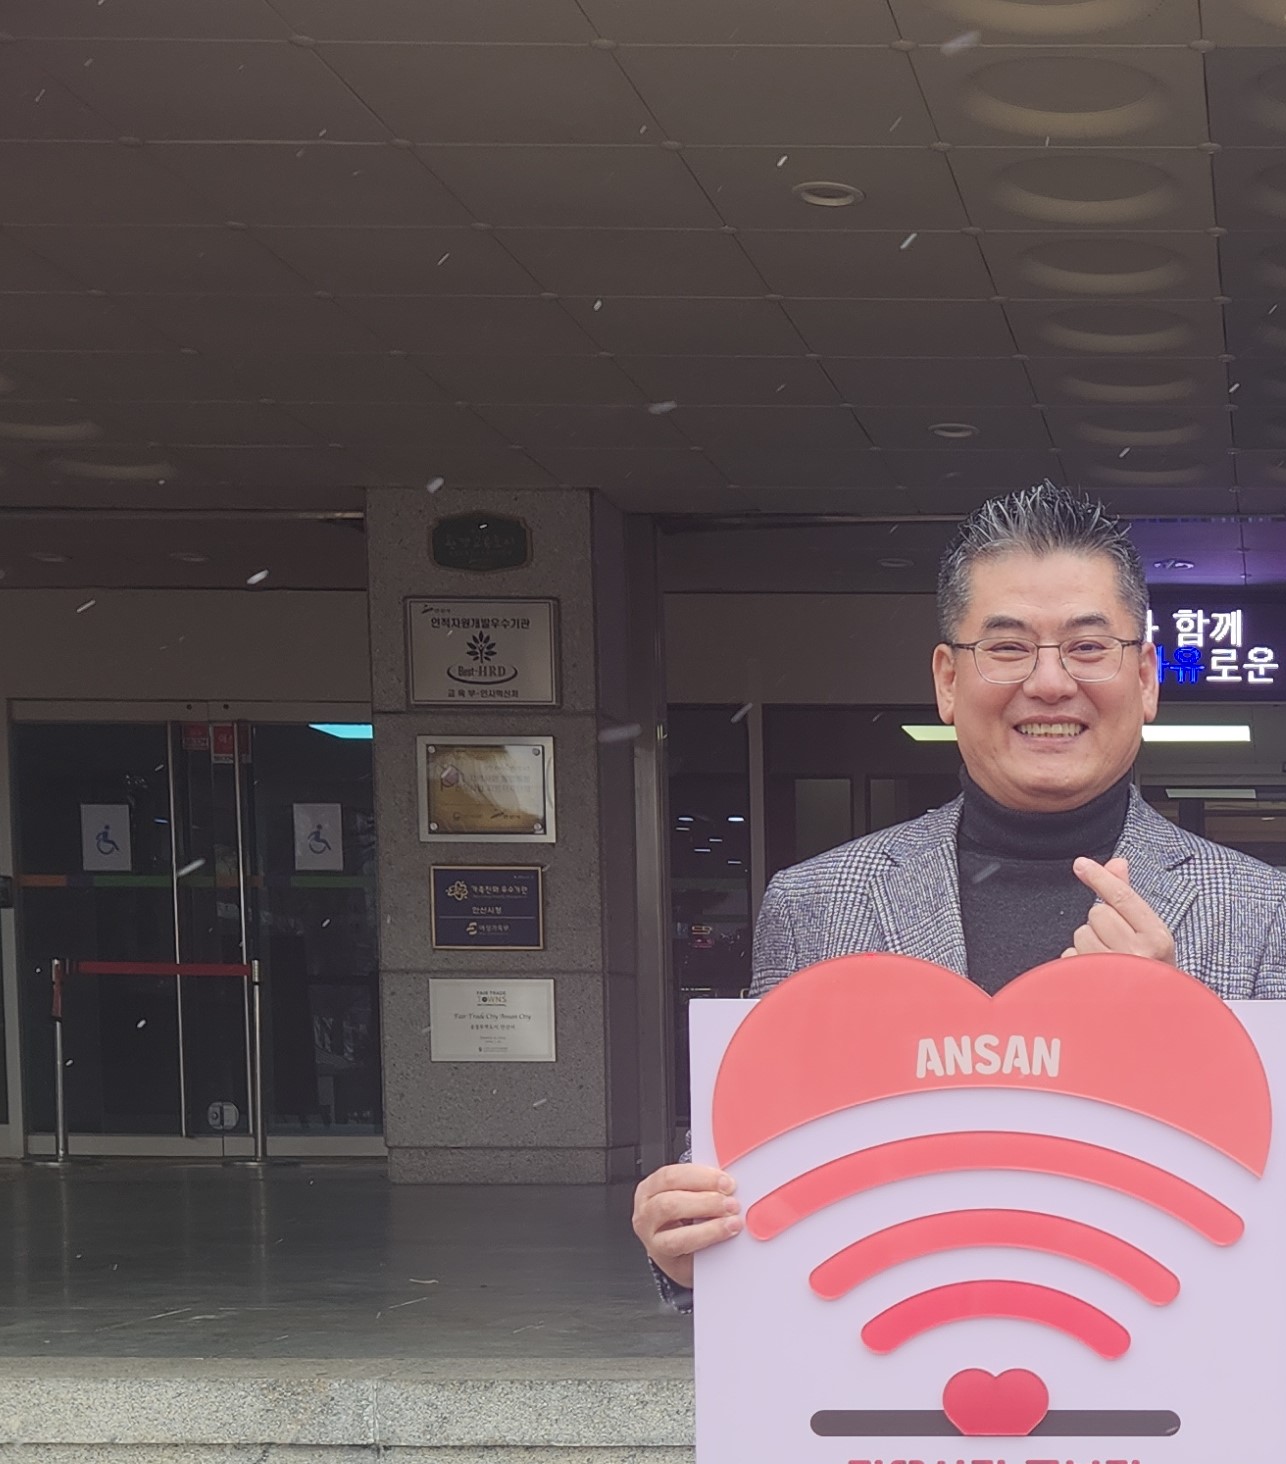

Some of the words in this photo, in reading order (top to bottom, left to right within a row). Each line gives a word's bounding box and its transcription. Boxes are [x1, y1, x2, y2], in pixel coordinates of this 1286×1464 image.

[430, 617, 531, 630] 인적자원개발우수기관
[1172, 609, 1243, 647] 함께
[915, 1034, 1062, 1078] ANSAN
